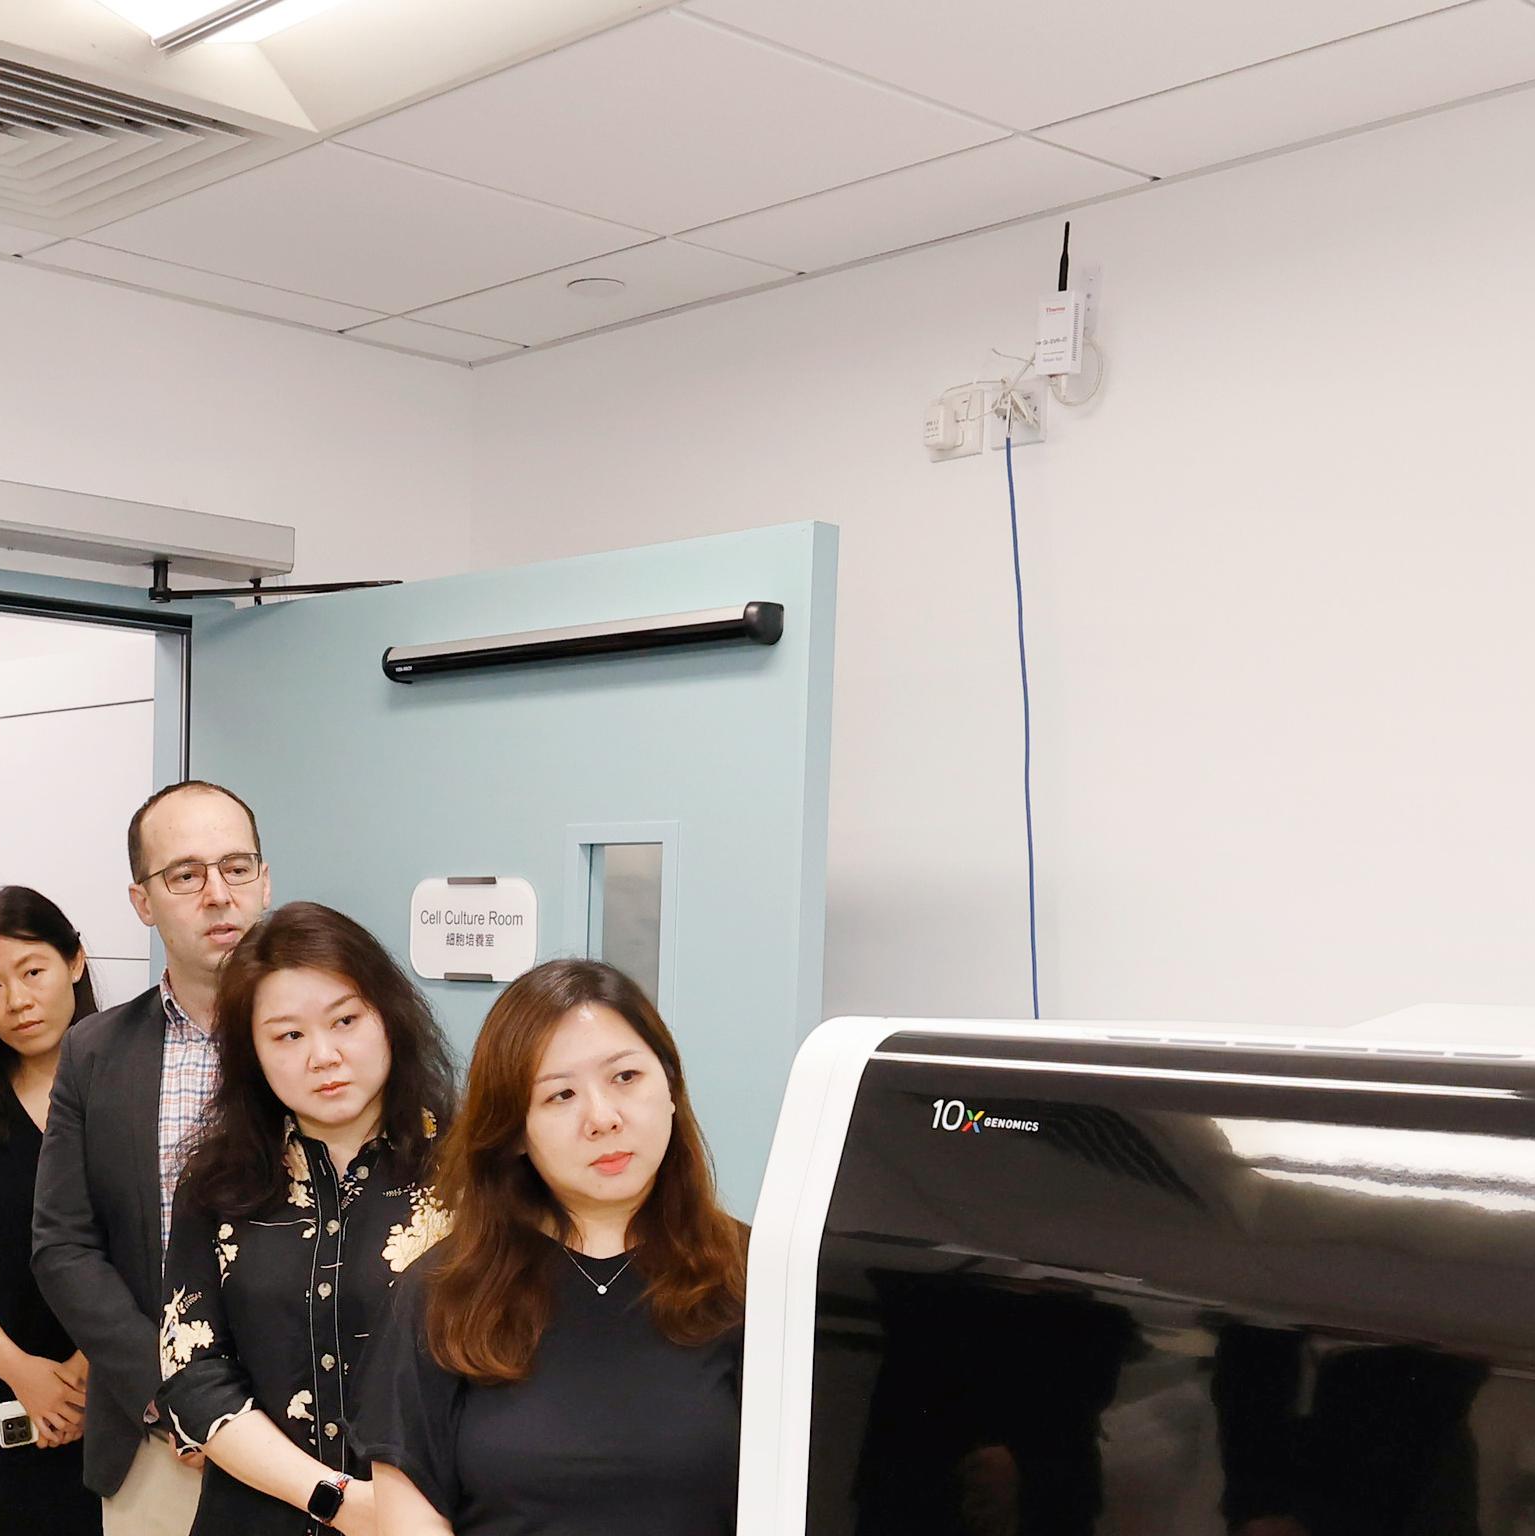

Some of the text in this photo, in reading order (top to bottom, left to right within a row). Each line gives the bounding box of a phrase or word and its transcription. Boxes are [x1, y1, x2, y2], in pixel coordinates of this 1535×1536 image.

[420, 910, 524, 927] Cell Culture Room
[445, 932, 495, 947] 細胞培養室
[983, 1116, 1040, 1133] GENOMICS
